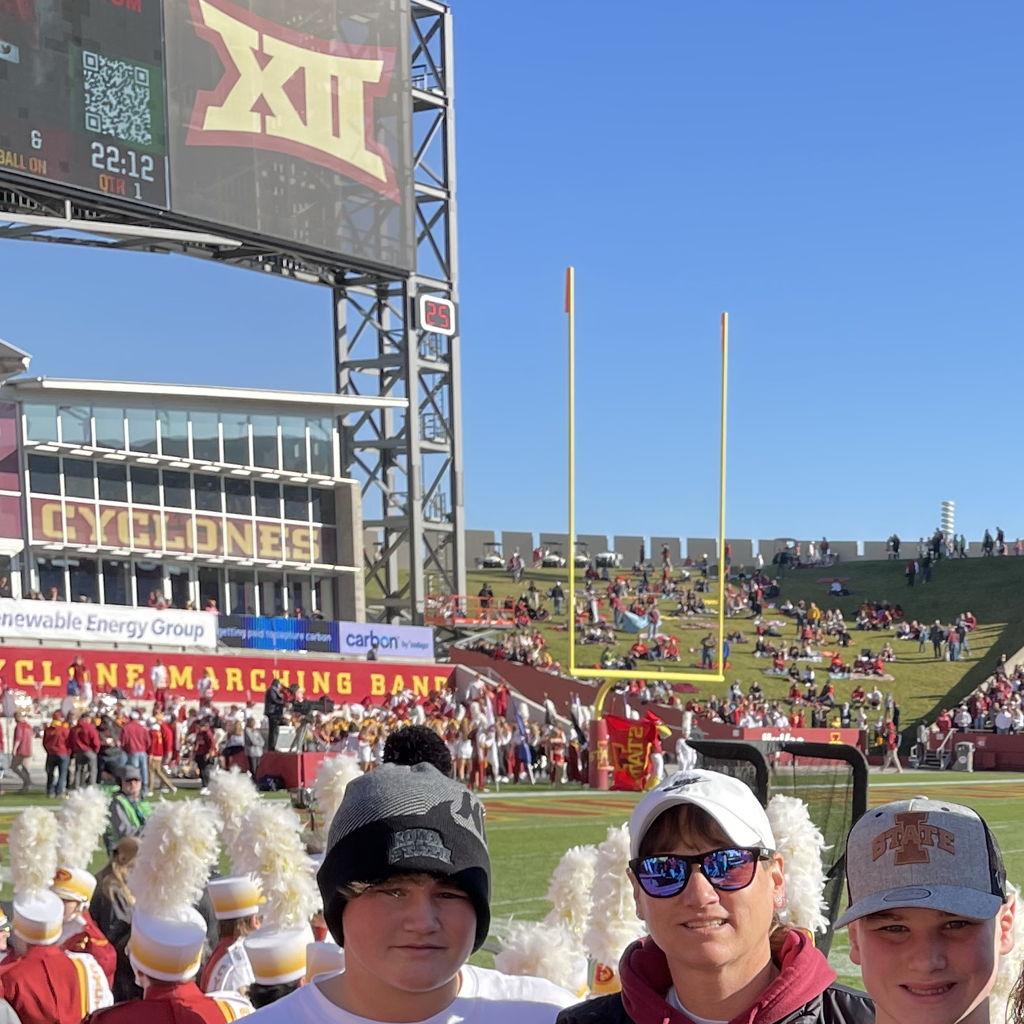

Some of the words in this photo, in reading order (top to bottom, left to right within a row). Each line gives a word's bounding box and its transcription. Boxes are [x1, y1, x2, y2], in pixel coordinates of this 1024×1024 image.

[91, 141, 154, 182] 22:12
[134, 182, 143, 200] 1
[41, 502, 321, 561] CYCLONES
[86, 614, 147, 638] Energy
[151, 618, 204, 642] Group
[346, 630, 398, 649] carbon
[0, 659, 145, 688] CLNE
[871, 825, 956, 862] STATE
